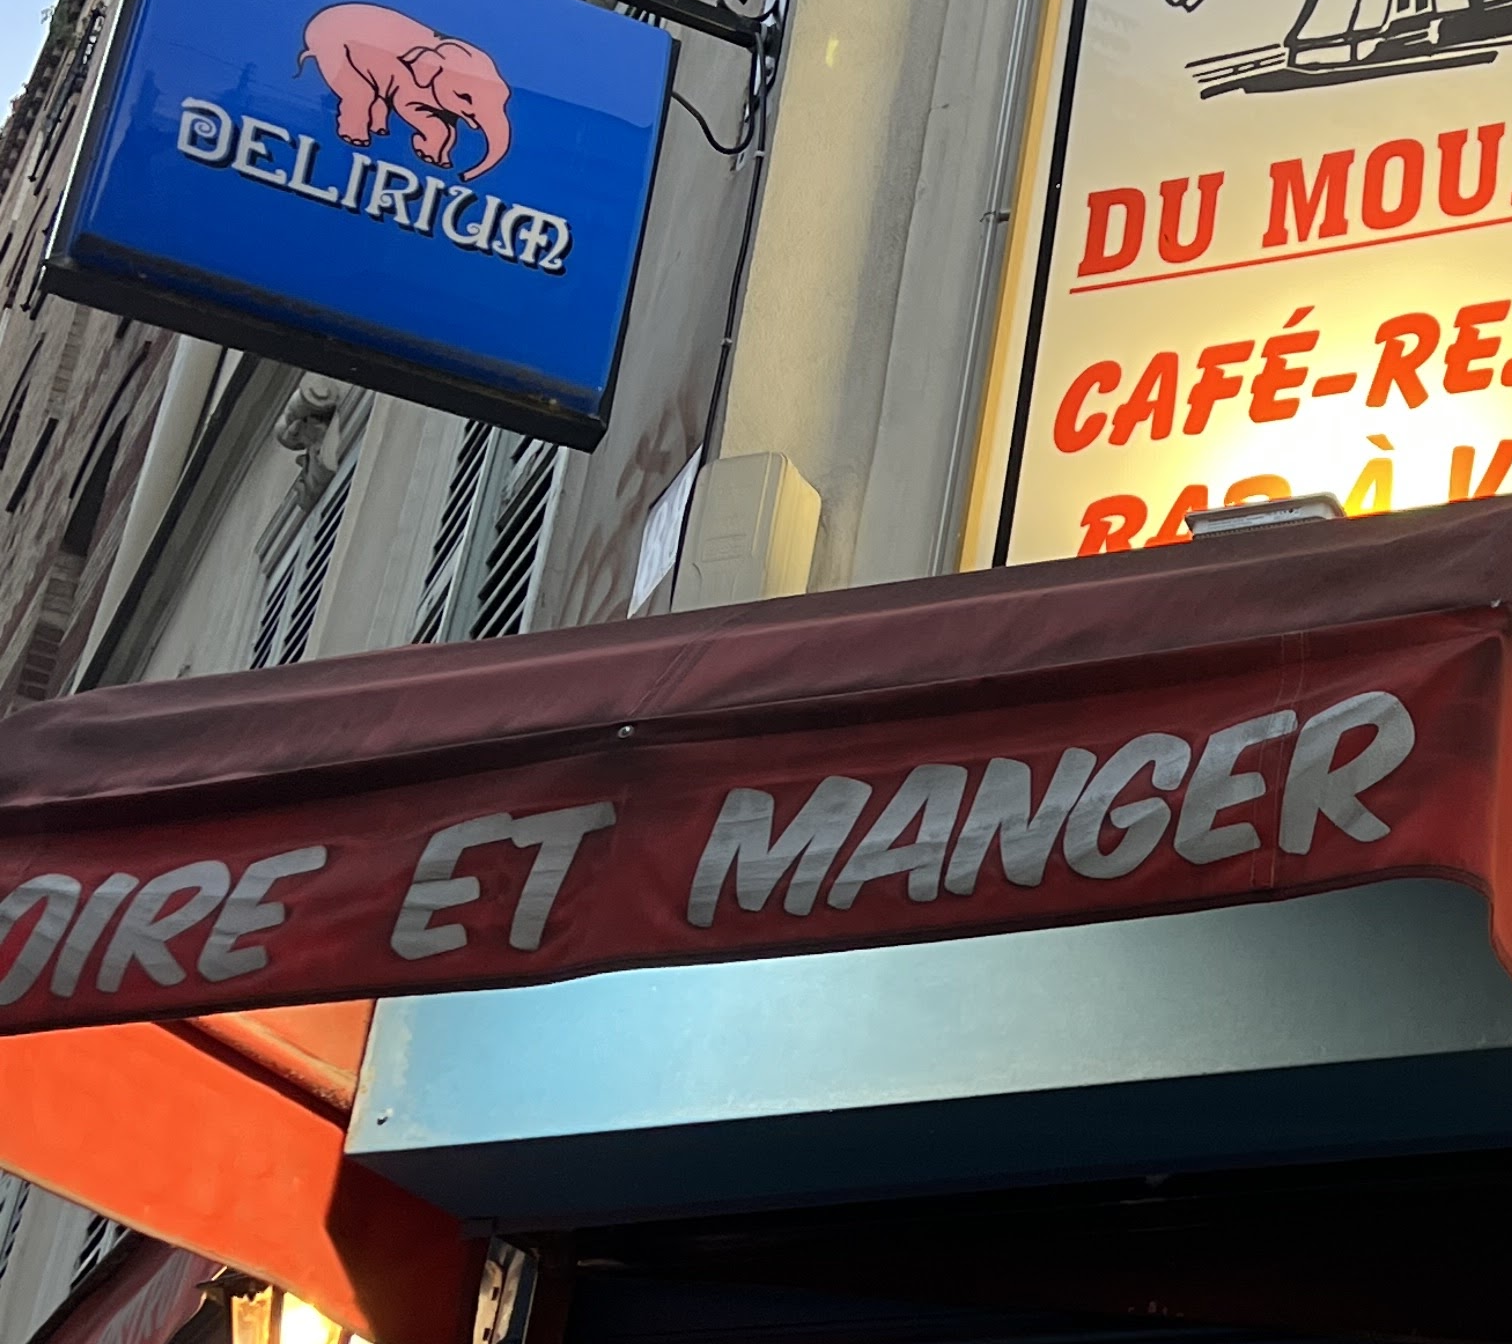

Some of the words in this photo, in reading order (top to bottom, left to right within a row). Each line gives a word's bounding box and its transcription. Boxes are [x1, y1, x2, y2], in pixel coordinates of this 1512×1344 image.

[176, 96, 573, 273] DELIRIUM
[1077, 170, 1225, 278] DU
[389, 800, 617, 961] ET
[686, 689, 1417, 929] MANGER
